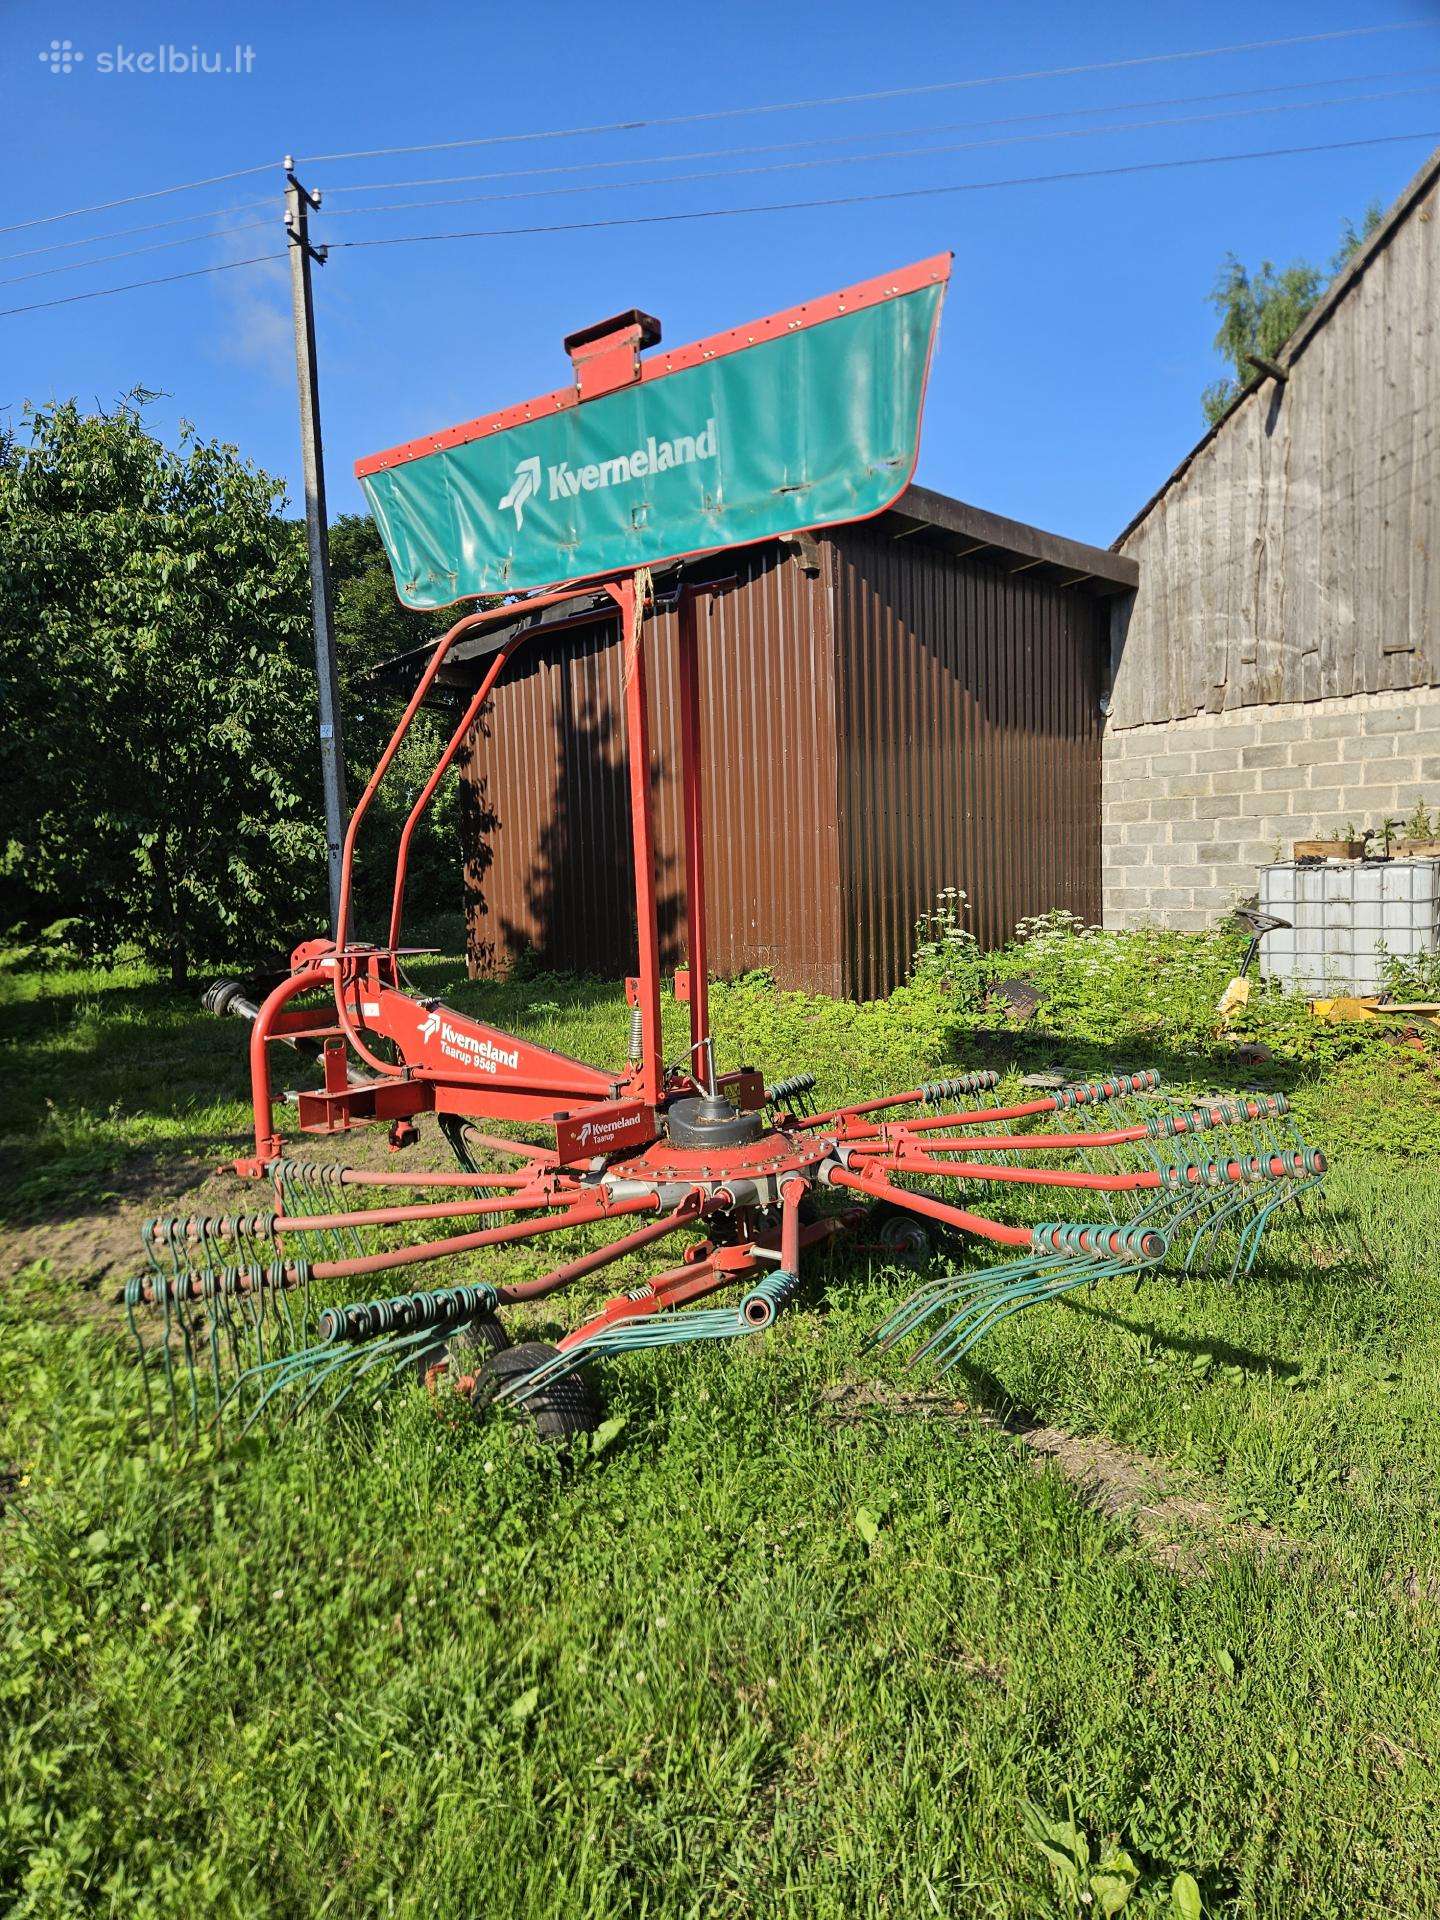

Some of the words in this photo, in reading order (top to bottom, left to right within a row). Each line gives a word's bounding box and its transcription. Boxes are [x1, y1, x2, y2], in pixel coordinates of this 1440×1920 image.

[548, 417, 717, 501] Kverneland
[440, 1040, 472, 1065] Taarup
[473, 1055, 497, 1074] 9546
[441, 1022, 519, 1069] Kverneland
[592, 1113, 641, 1135] Kverneland
[593, 1133, 615, 1144] Taarup
